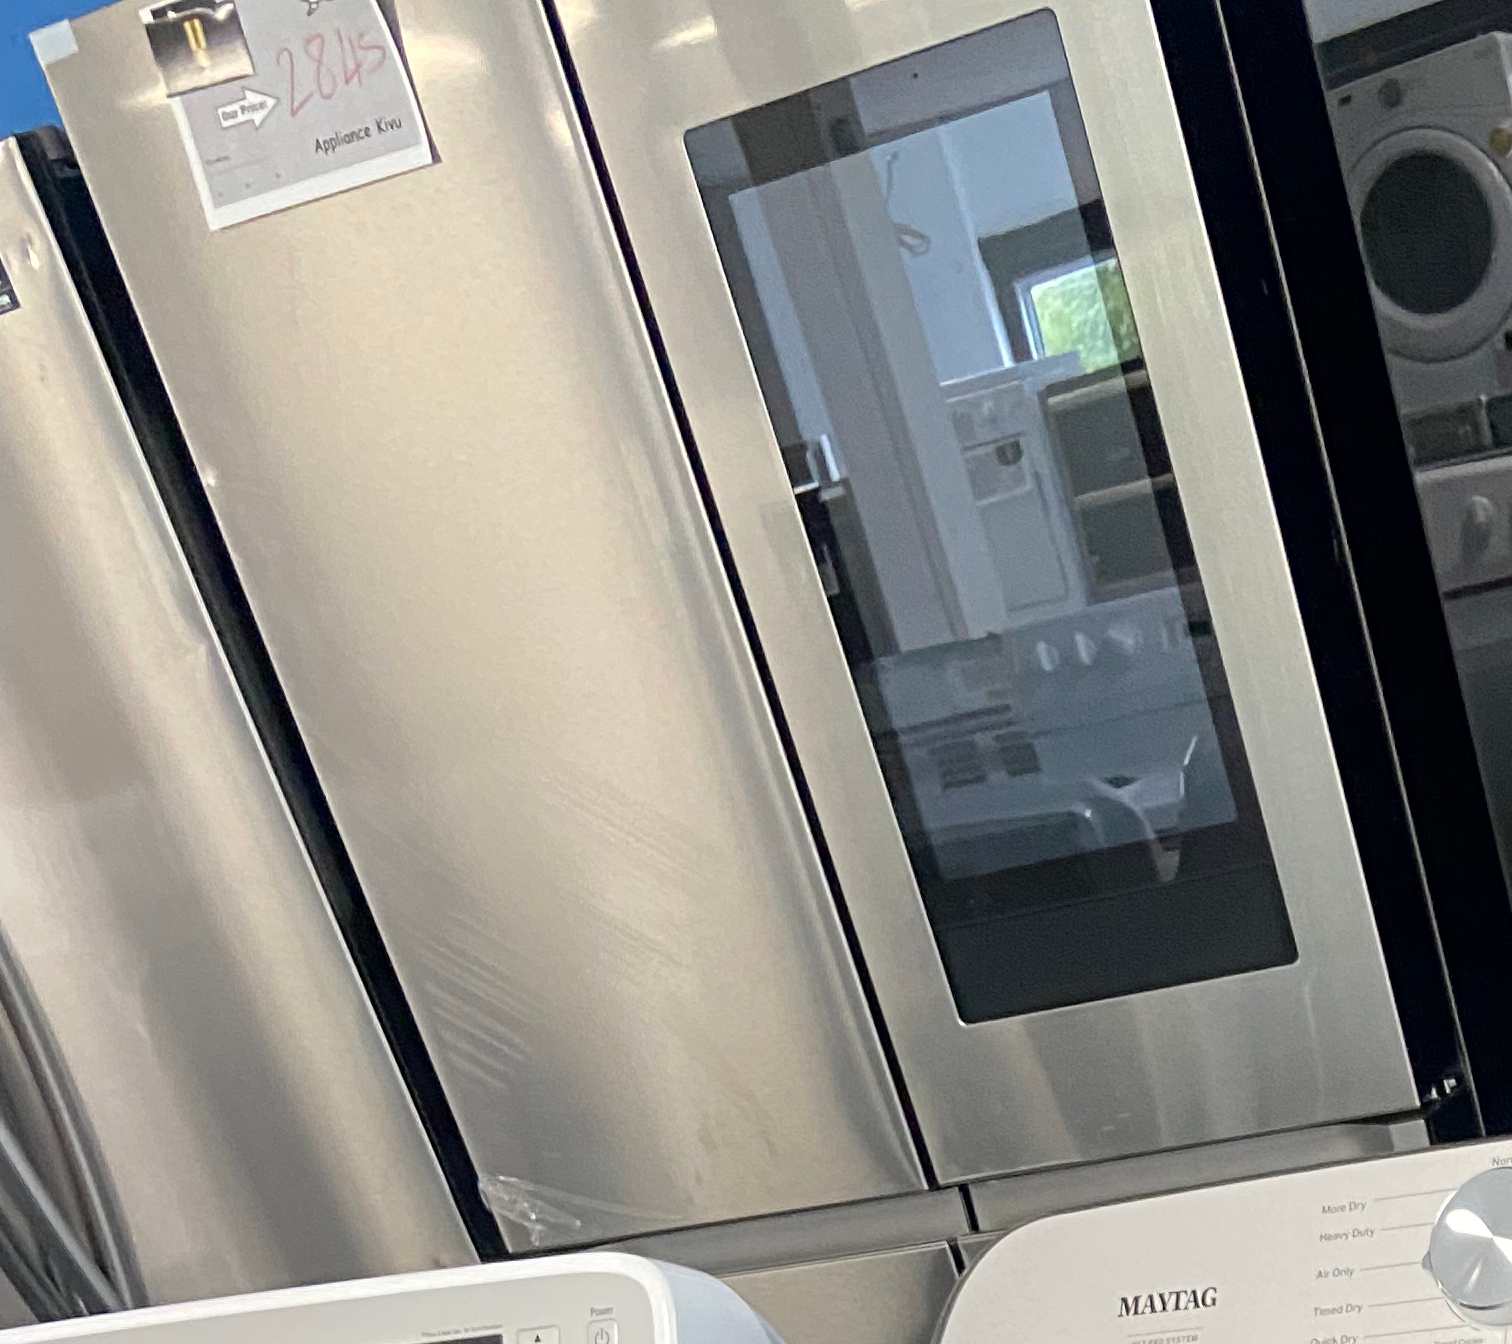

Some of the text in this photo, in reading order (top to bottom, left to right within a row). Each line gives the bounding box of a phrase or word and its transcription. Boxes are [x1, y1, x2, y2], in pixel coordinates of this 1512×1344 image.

[277, 29, 387, 117] 2845
[314, 117, 402, 155] Appliance Kivu
[1322, 1201, 1367, 1214] More Dry
[1320, 1227, 1376, 1243] Heavy Duty
[1316, 1266, 1356, 1280] Air Only
[1118, 1286, 1218, 1318] MAYTAG
[590, 1306, 614, 1317] Power
[1313, 1303, 1364, 1317] Timed Dry
